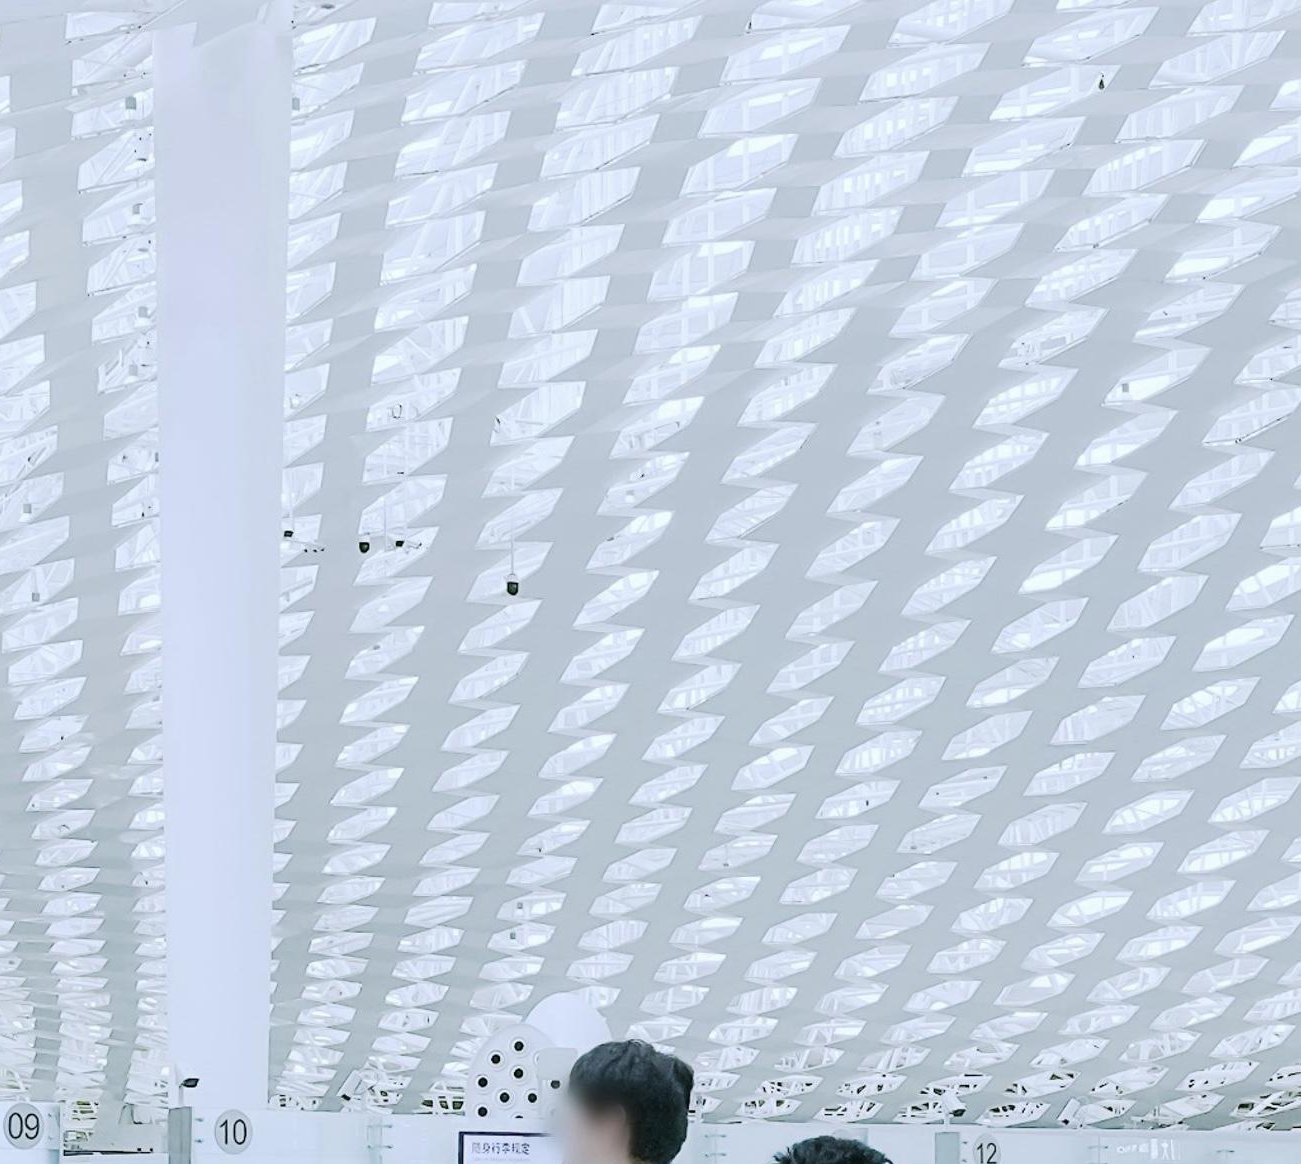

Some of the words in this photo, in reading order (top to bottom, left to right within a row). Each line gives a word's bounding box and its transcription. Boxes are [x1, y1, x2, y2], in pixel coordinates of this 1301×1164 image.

[8, 1112, 40, 1140] 09
[219, 1119, 248, 1145] 10
[977, 1142, 998, 1164] 12
